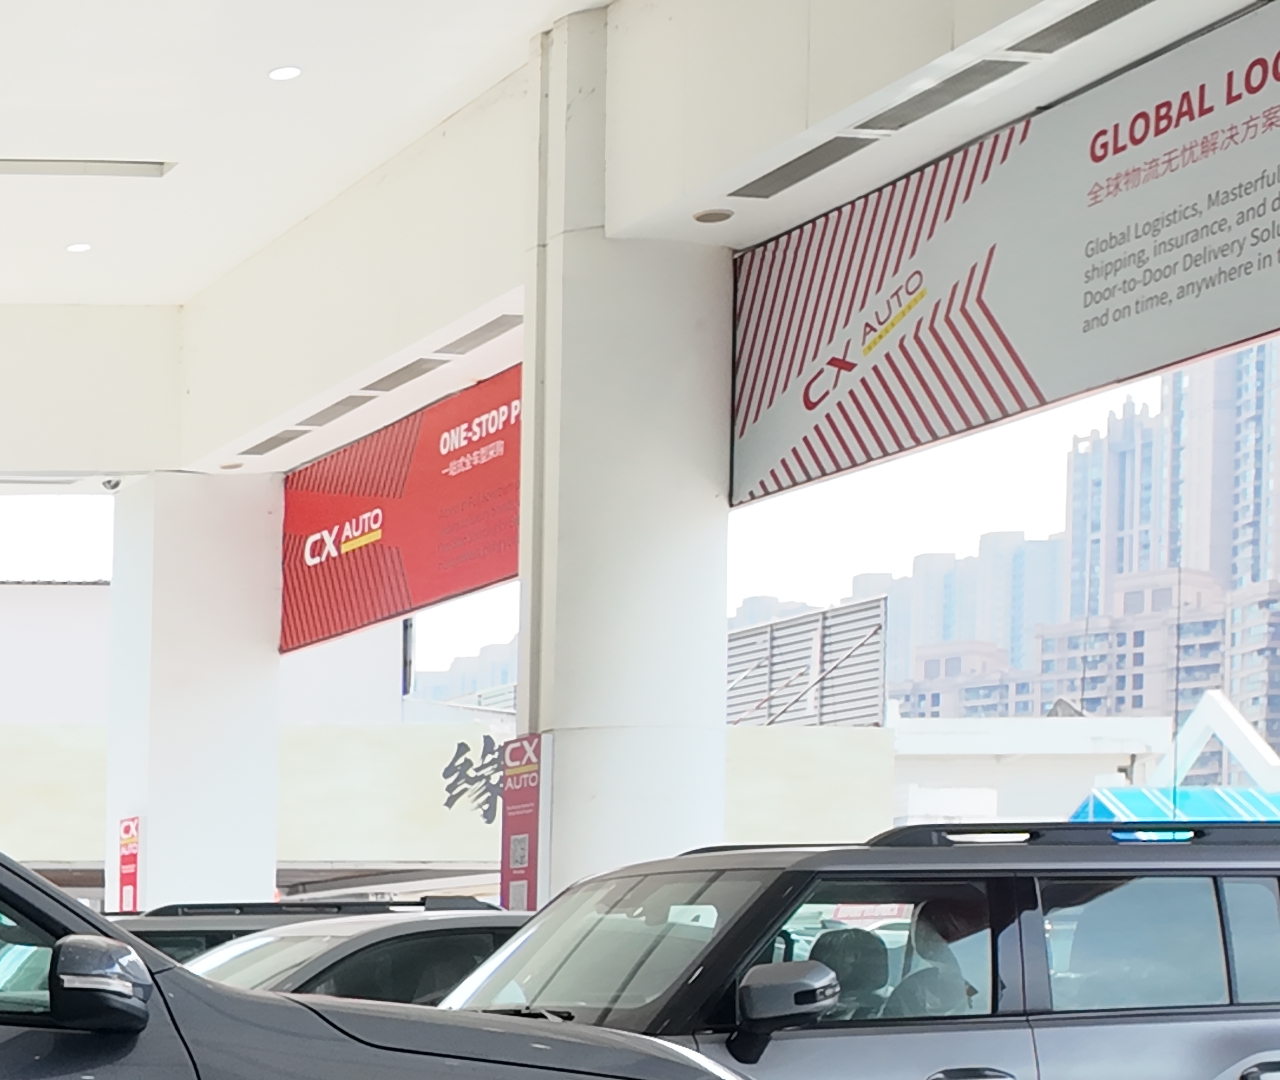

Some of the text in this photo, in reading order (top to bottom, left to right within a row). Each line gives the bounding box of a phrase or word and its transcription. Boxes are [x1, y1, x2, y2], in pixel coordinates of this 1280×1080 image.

[1087, 104, 1280, 208] 全球物流无忧解决方案
[1090, 83, 1215, 163] GLOBAL
[1084, 248, 1150, 284] shipping,
[1152, 217, 1232, 257] insurance,
[1236, 197, 1267, 227] and
[1085, 225, 1131, 258] Global
[1134, 202, 1203, 240] Logistics,
[1082, 307, 1109, 333] and
[1112, 304, 1131, 323] on
[1135, 291, 1172, 314] time,
[1176, 261, 1253, 300] anywhere
[1257, 252, 1272, 271] in
[1083, 261, 1179, 308] Door-to-Door
[1183, 237, 1246, 272] Delivery
[803, 338, 858, 411] CX
[862, 270, 923, 346] AUTO
[440, 405, 509, 455] ONE-STOP
[304, 525, 339, 566] CX
[341, 508, 382, 543] AUTO
[504, 738, 539, 767] CX
[504, 772, 538, 791] AUTO
